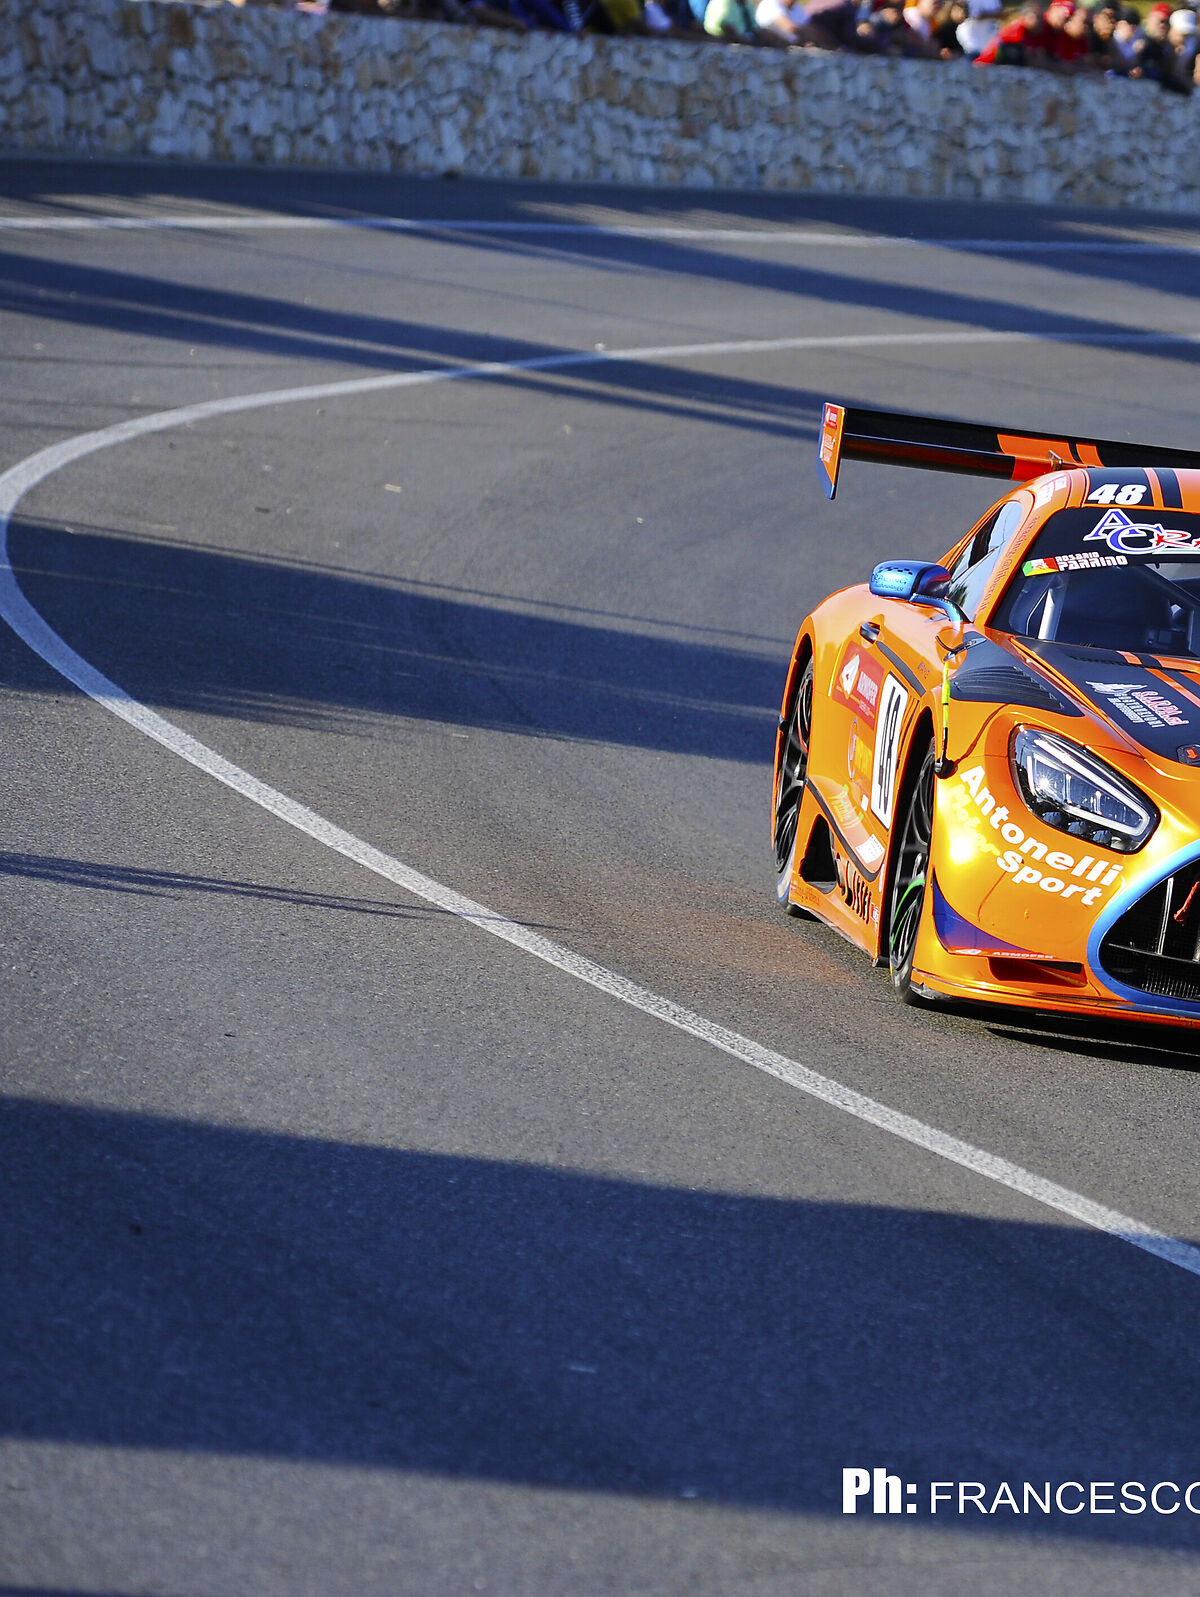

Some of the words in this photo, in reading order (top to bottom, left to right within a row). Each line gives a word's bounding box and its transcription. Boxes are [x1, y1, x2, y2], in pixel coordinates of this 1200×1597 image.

[1087, 484, 1147, 505] 48
[1055, 552, 1100, 562] ROSARIO
[1058, 555, 1128, 571] PARRINO
[960, 765, 1124, 886] Antonelli
